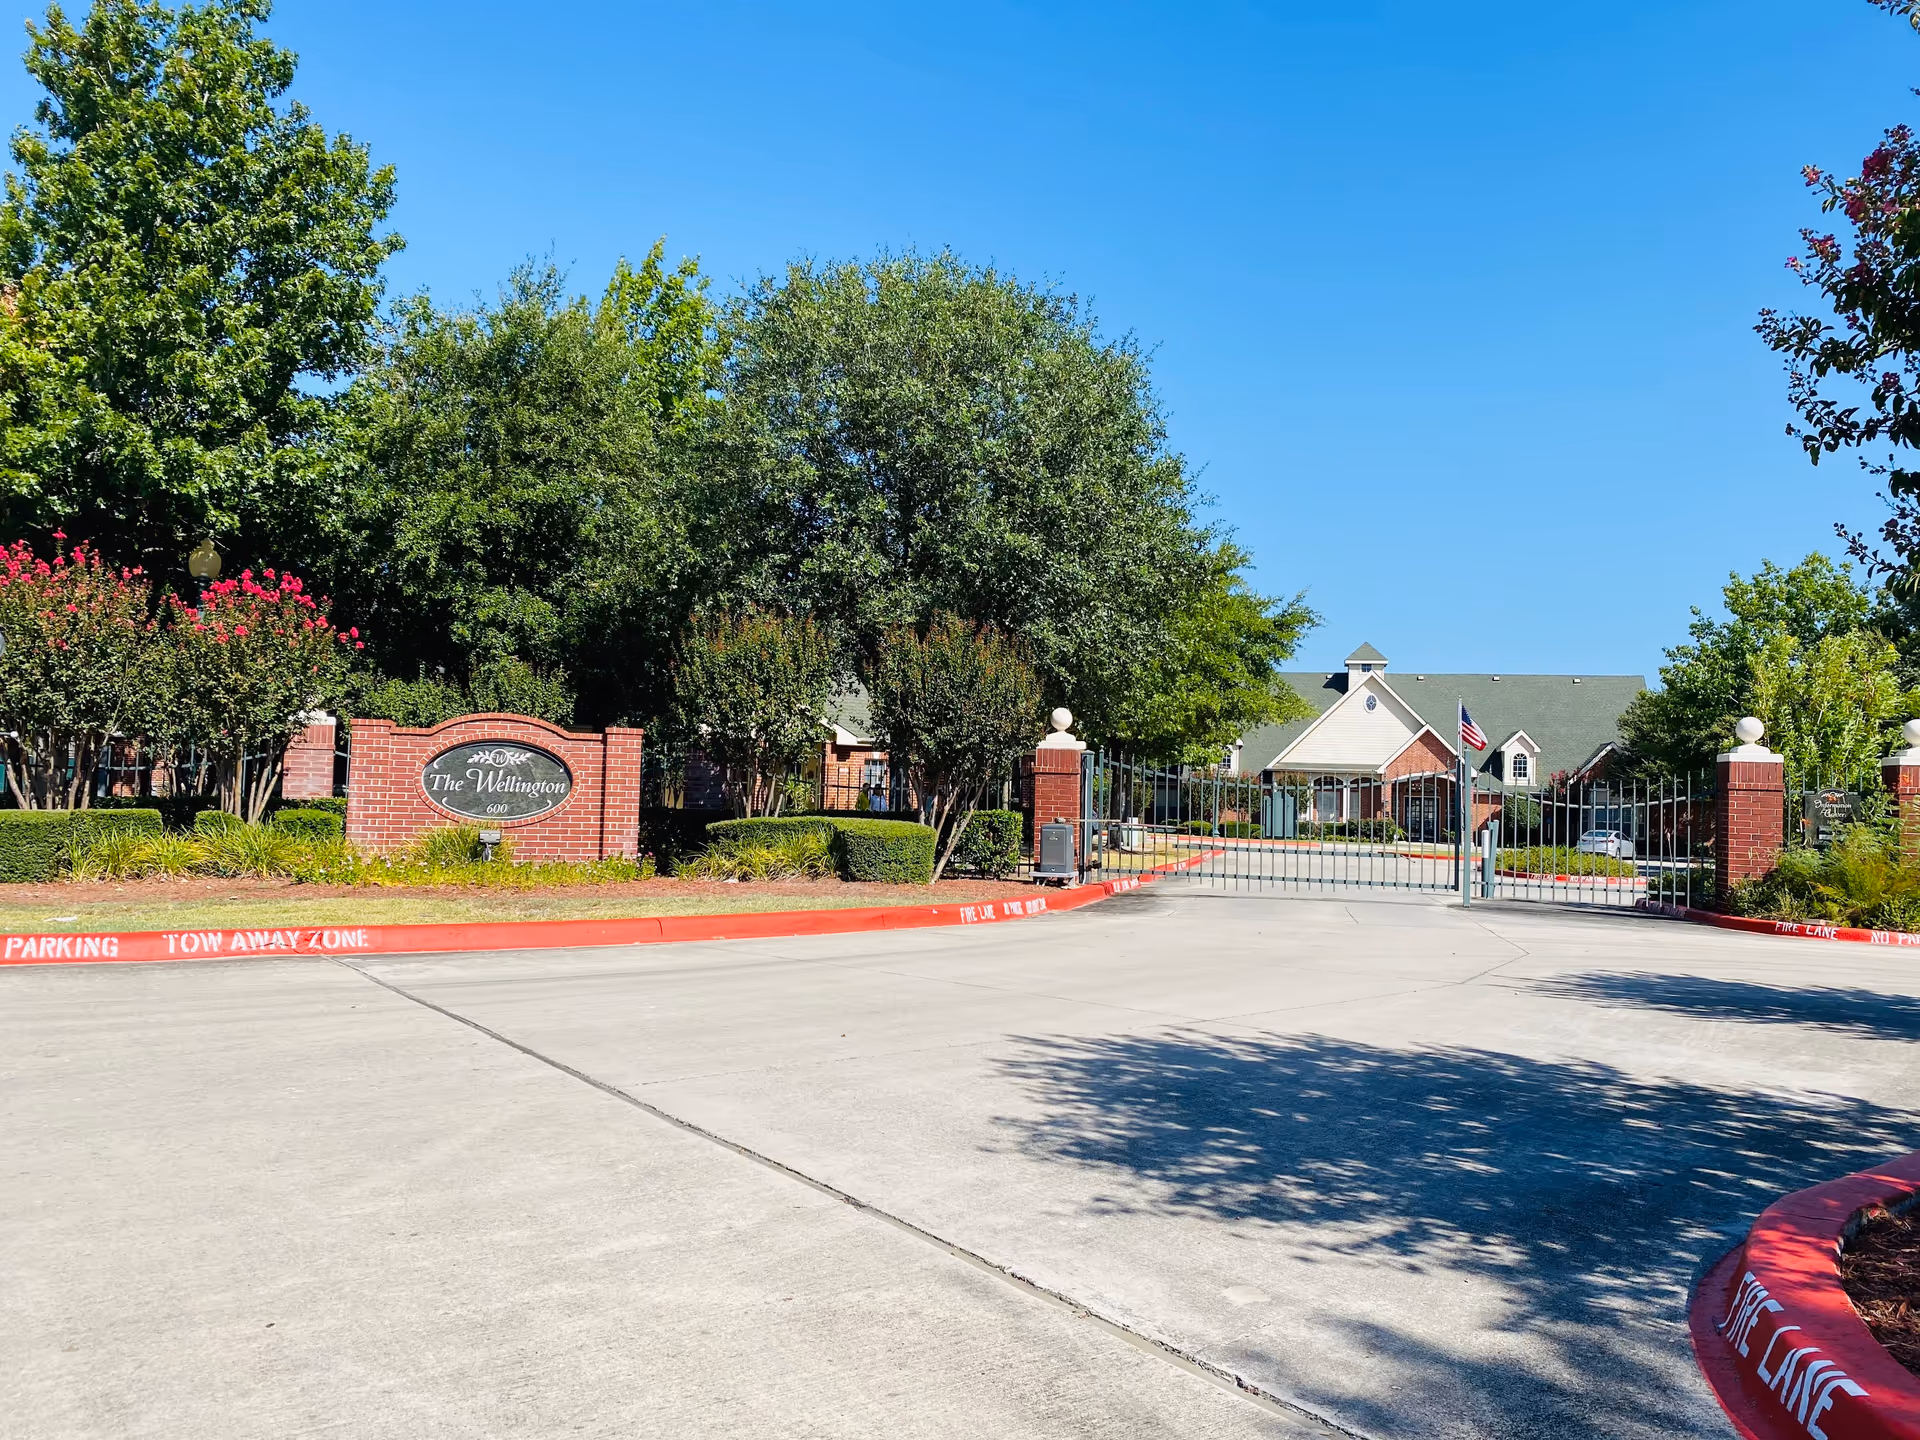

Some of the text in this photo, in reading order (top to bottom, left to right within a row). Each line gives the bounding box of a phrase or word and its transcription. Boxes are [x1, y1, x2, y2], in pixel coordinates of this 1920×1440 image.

[429, 768, 566, 798] The Wellington
[486, 803, 508, 814] 600
[959, 906, 978, 924] FIRE
[1775, 921, 1840, 940] FIRE LANE
[1870, 931, 1890, 944] NO
[4, 937, 120, 959] PARKING
[162, 929, 369, 954] TOW AWAY ZONE
[1717, 1271, 1871, 1440] FIRE LANE
